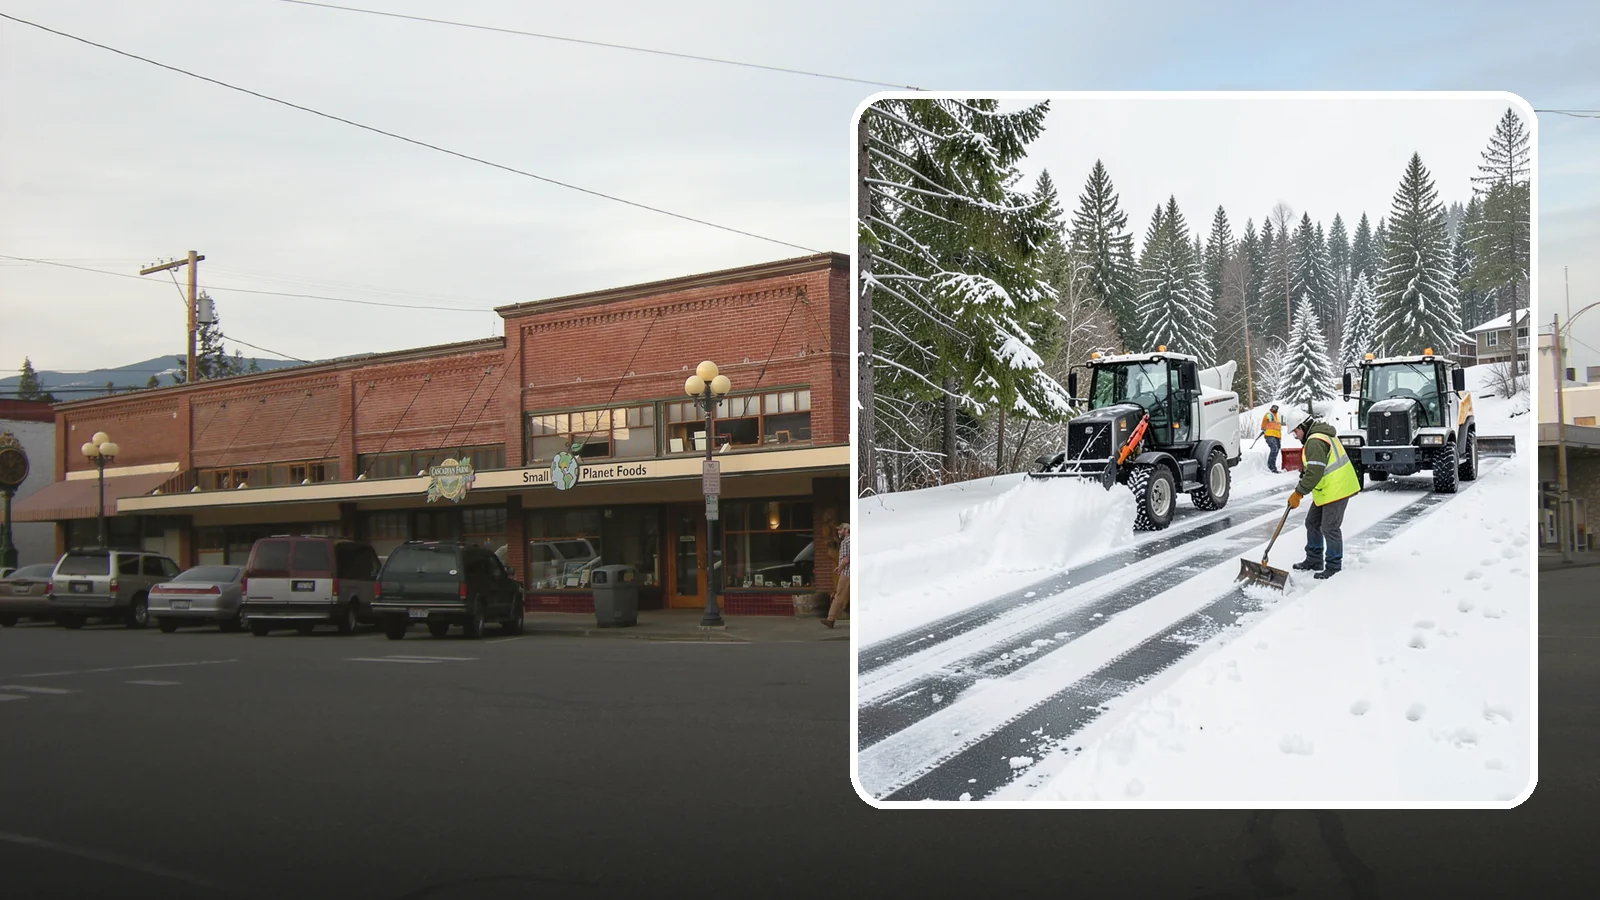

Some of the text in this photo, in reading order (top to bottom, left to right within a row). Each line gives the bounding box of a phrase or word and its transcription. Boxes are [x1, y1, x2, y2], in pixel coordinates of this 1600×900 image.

[523, 464, 647, 483] Small Planet Foods
